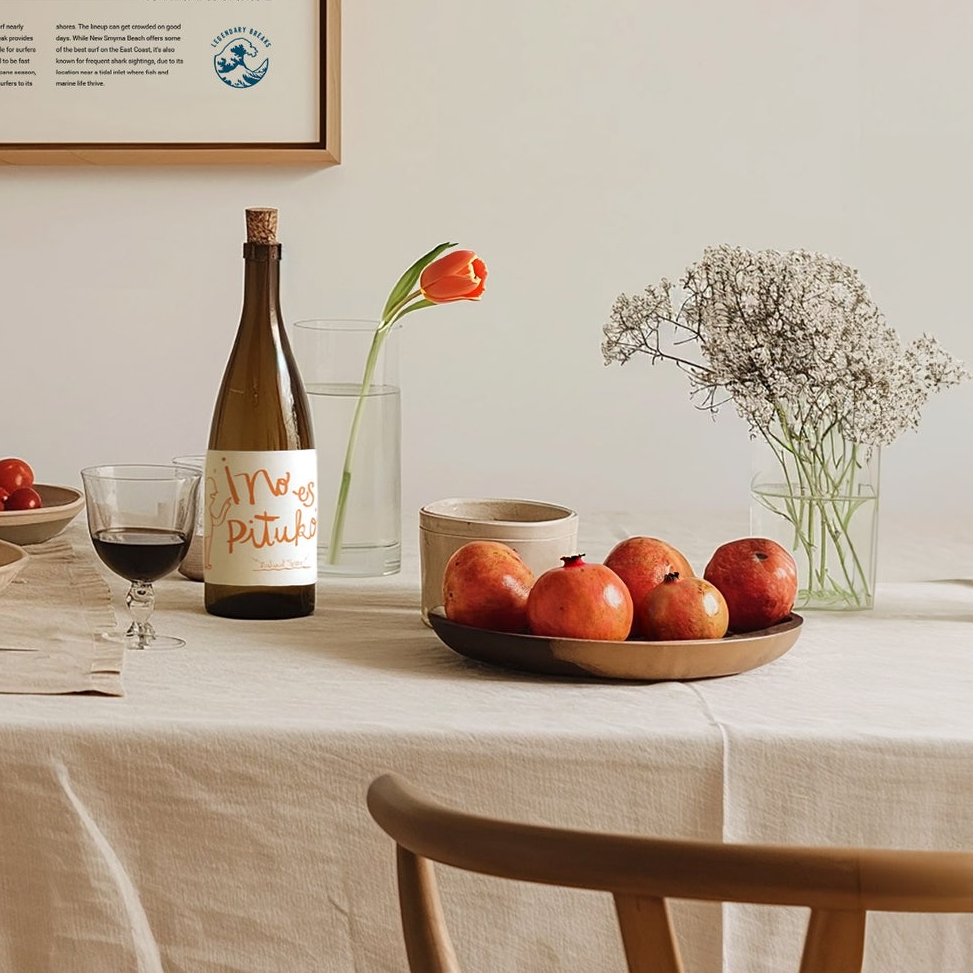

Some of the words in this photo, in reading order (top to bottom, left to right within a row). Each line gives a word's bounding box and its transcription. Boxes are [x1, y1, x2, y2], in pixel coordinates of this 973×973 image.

[5, 23, 24, 32] nearly
[89, 23, 108, 32] lineup
[120, 23, 131, 32] get
[166, 23, 182, 32] good
[8, 34, 34, 43] provides
[72, 34, 89, 42] While
[89, 34, 103, 42] New
[103, 34, 126, 43] Smyrna
[126, 34, 146, 42] Beach
[145, 34, 164, 42] offers
[210, 26, 246, 48] LEGENDARY
[249, 28, 272, 48] BREAKS
[85, 57, 110, 66] frequent
[18, 79, 25, 87] to
[25, 79, 33, 87] its
[55, 79, 76, 87] marine
[76, 79, 87, 87] life
[292, 481, 315, 507] es
